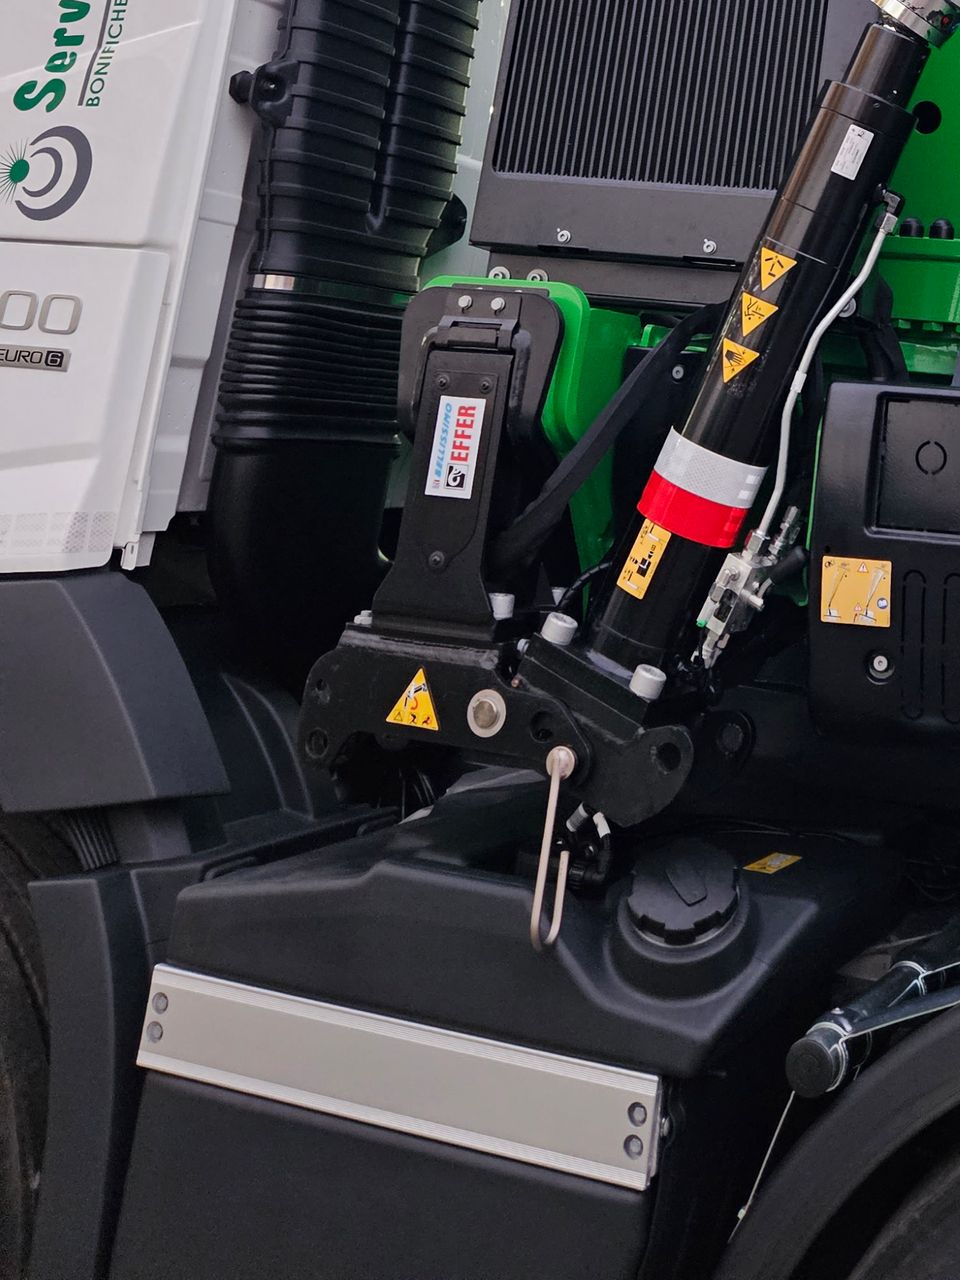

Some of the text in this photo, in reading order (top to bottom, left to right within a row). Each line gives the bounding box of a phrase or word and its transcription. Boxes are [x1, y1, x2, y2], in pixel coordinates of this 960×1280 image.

[0, 348, 63, 367] EURO 6
[434, 402, 453, 478] BELLISSIMO
[449, 405, 477, 463] EFFER
